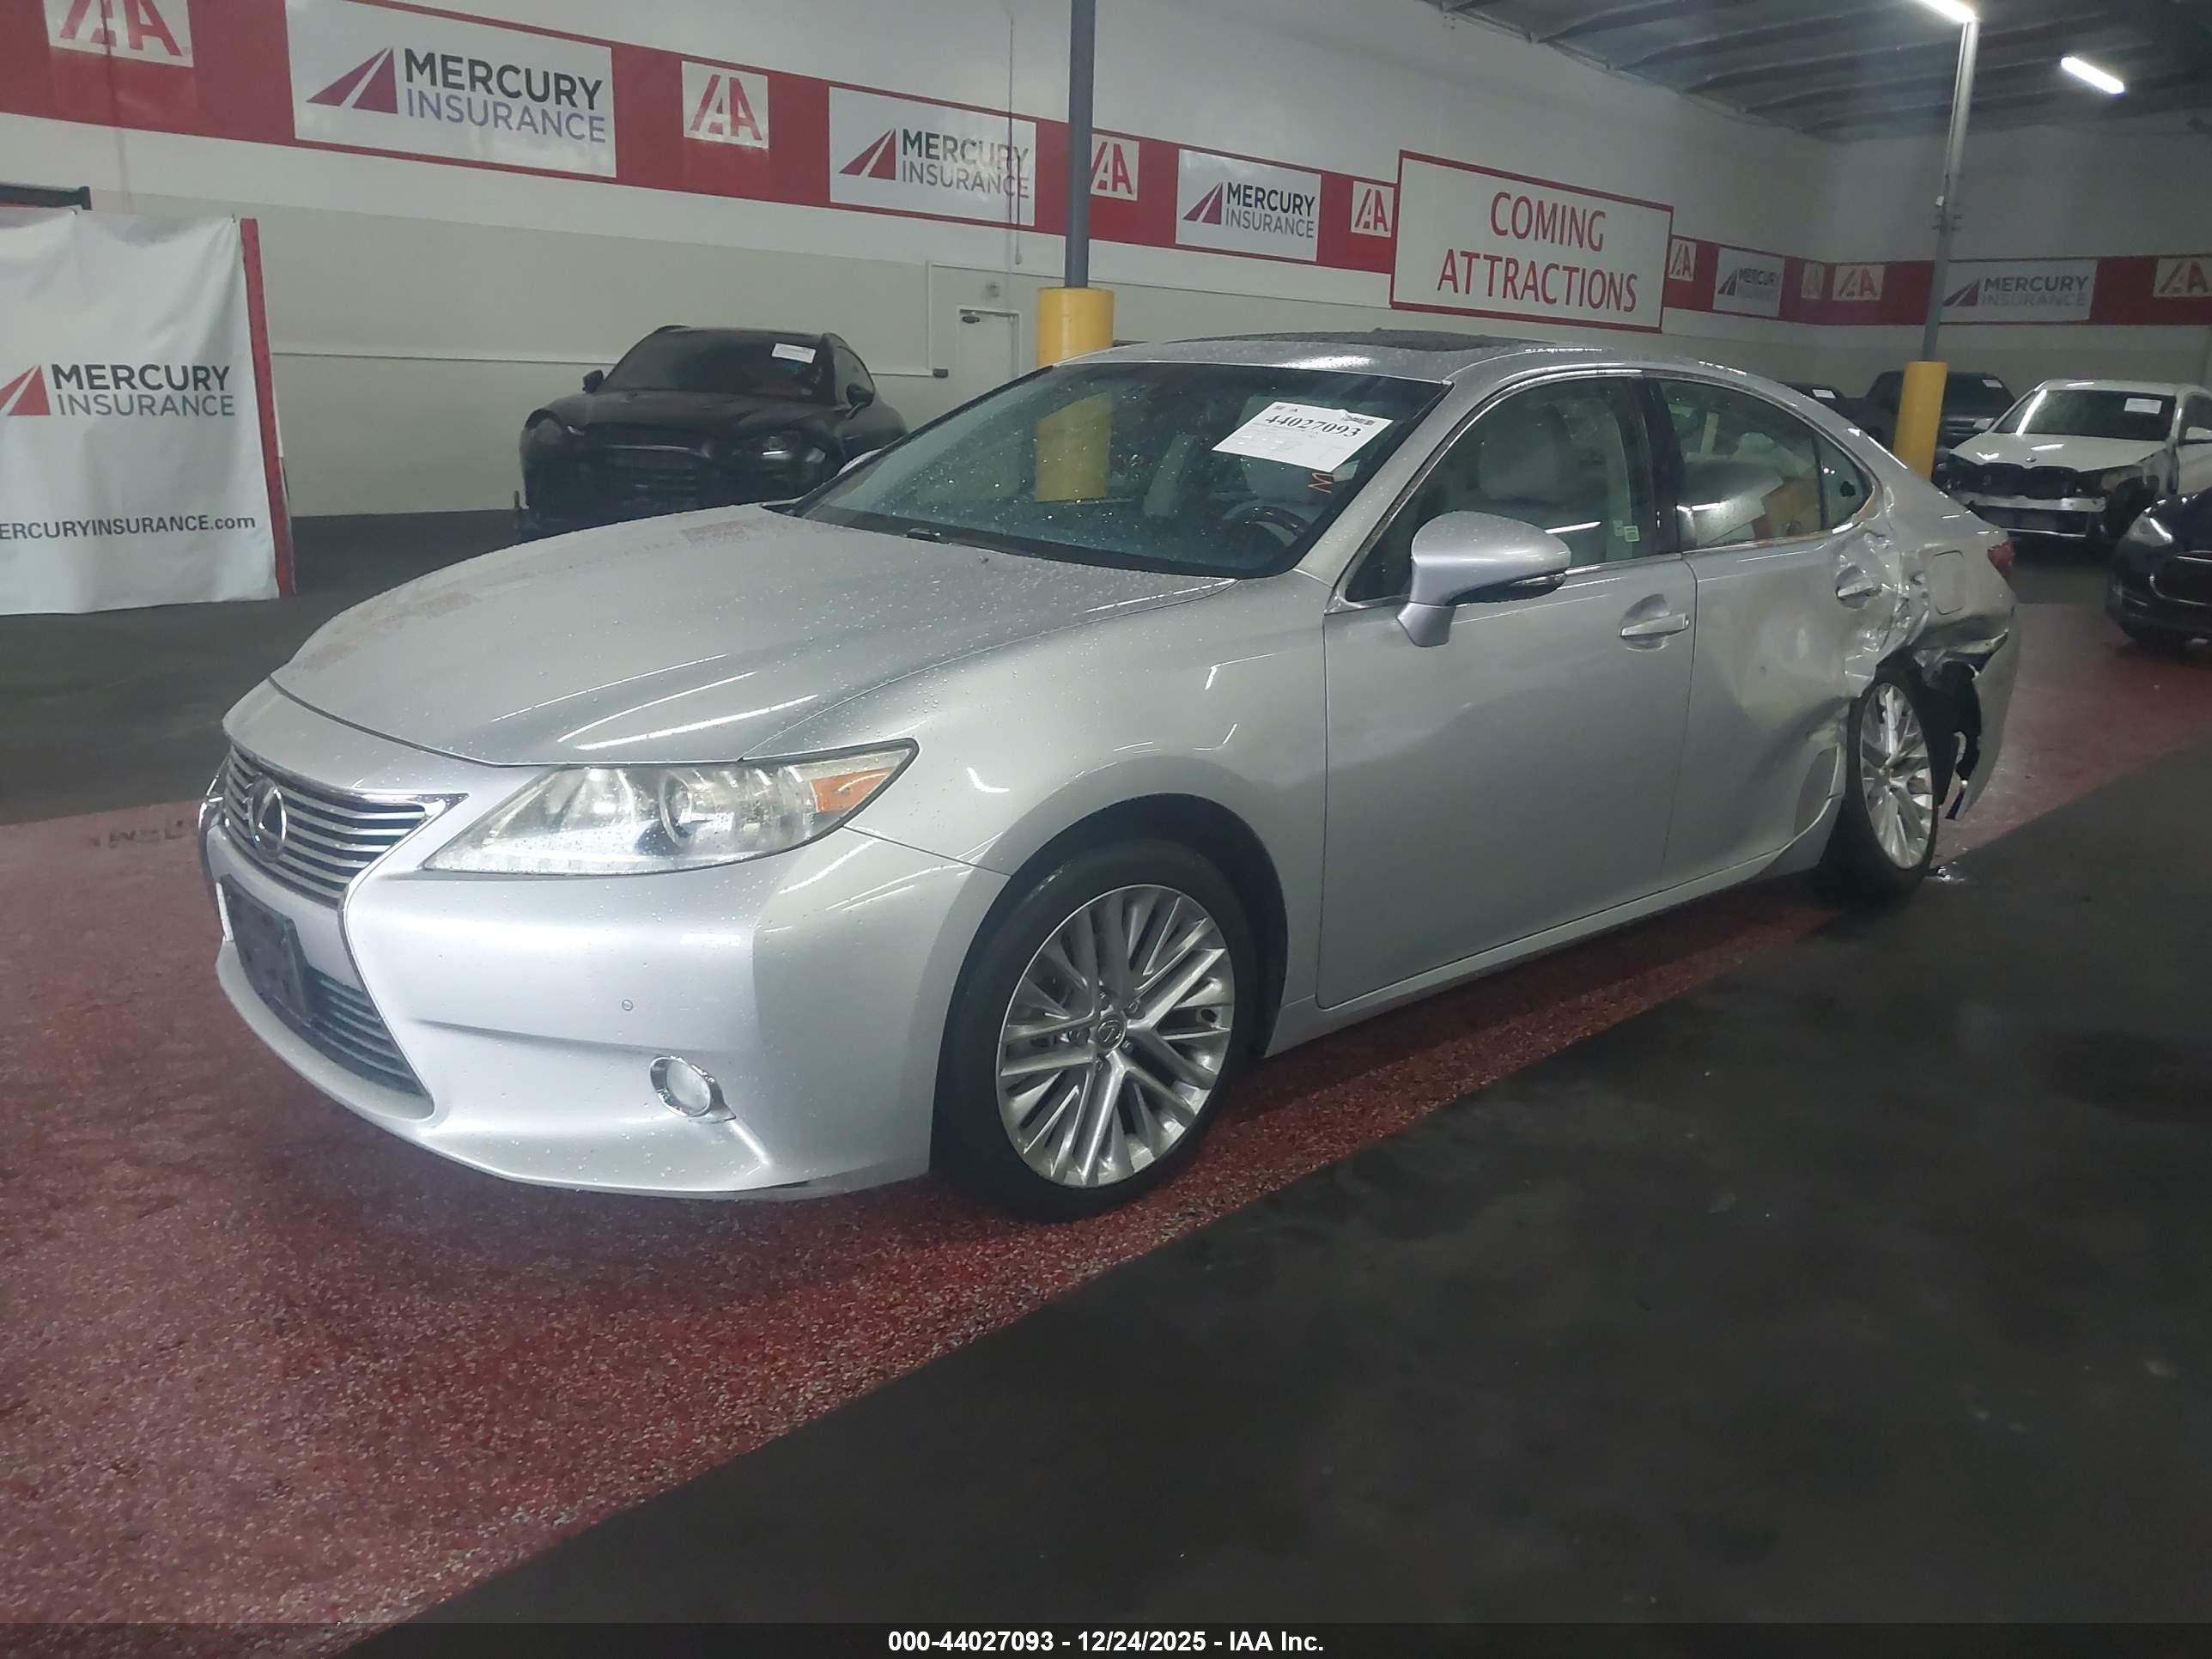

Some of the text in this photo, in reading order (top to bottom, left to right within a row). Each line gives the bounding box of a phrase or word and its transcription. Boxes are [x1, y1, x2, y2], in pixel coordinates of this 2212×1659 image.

[404, 47, 603, 111] MERCURY
[407, 88, 606, 143] INSURANCE
[902, 128, 1030, 172] MERCURY
[902, 160, 1030, 199] INSURANCE
[1226, 181, 1316, 217] MERCURY
[1225, 208, 1315, 239] INSURANCE
[1490, 191, 1607, 252] COMING
[1437, 248, 1638, 313] ATTRACTIONS
[1984, 275, 2089, 293] MERCURY
[1979, 293, 2087, 307] INSURANCE
[51, 363, 230, 392] MERCURY
[57, 393, 235, 416] INSURANCE
[1264, 414, 1362, 437] 44027093
